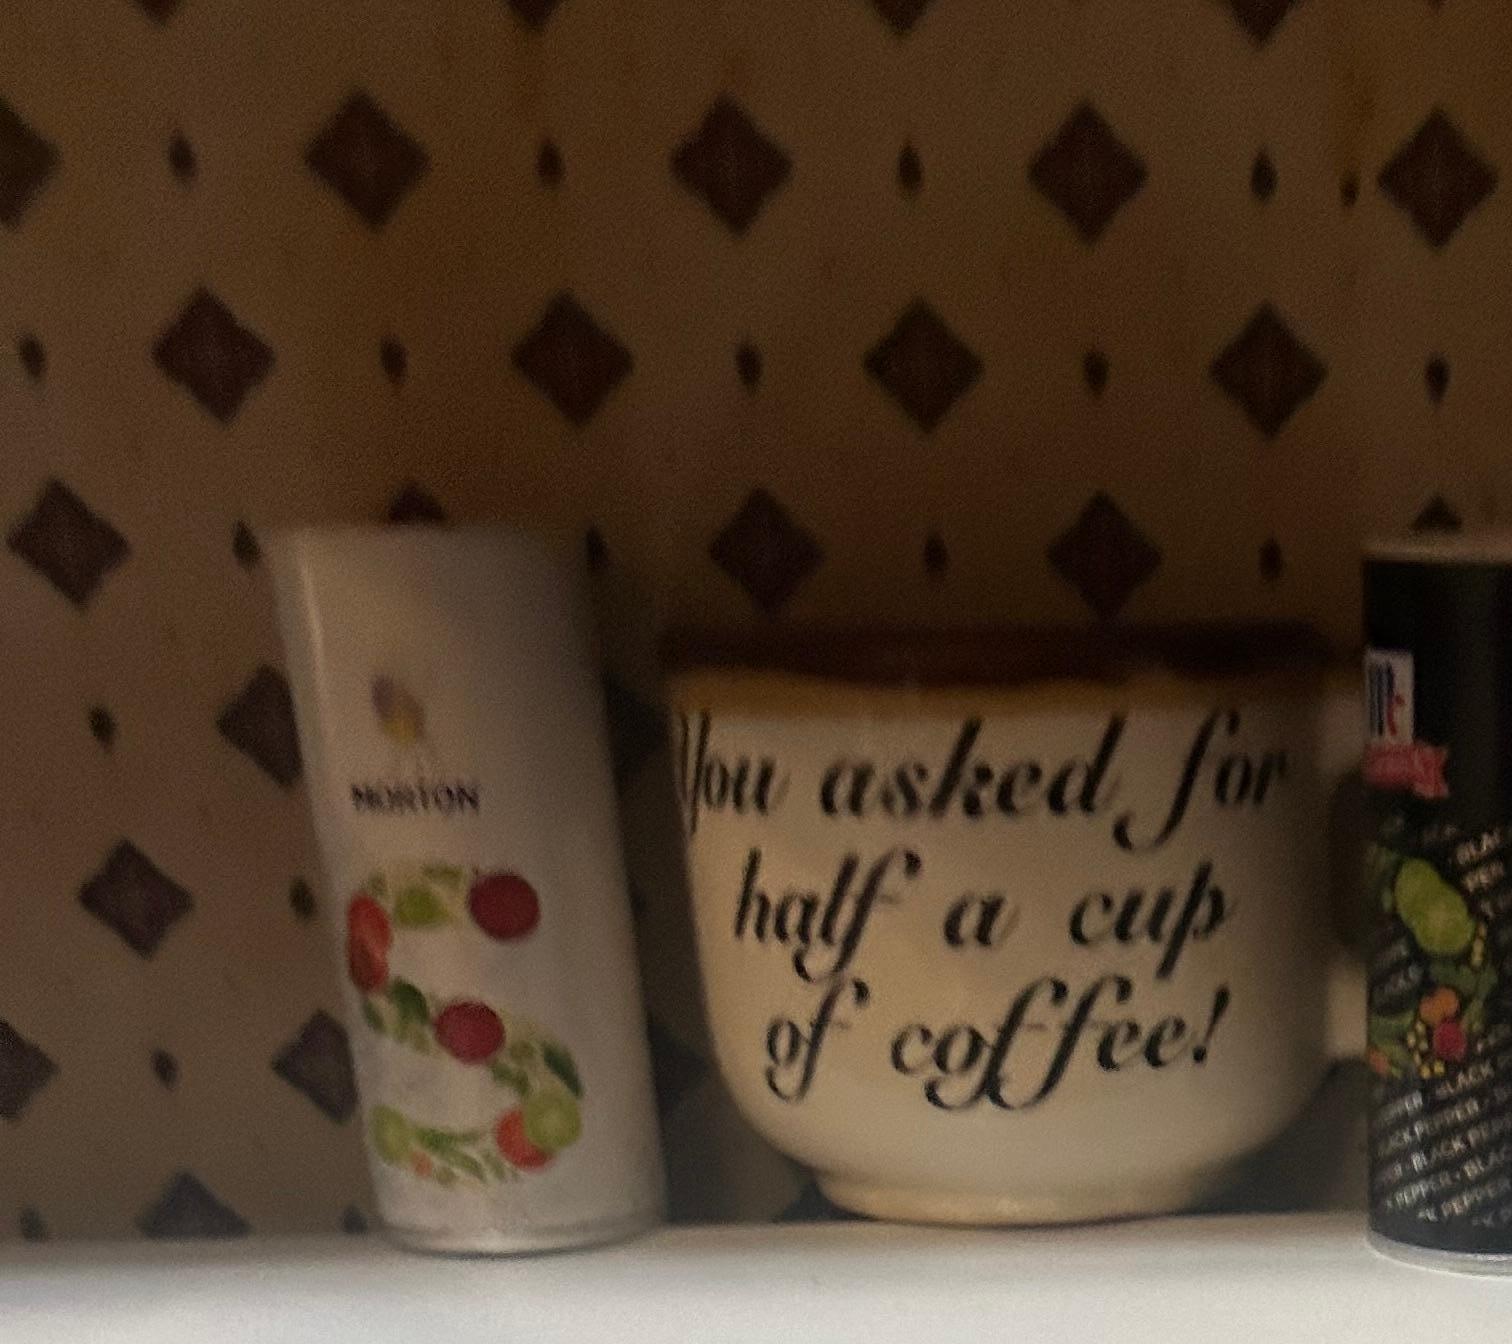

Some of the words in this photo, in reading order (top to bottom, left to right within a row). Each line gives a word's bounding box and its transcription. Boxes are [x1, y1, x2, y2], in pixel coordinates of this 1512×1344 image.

[818, 715, 1128, 820] asked
[1111, 705, 1291, 853] for
[734, 846, 922, 985] half
[942, 889, 1018, 948] a
[1068, 860, 1232, 981] cup
[764, 976, 871, 1104] of
[889, 974, 1232, 1111] coffee!
